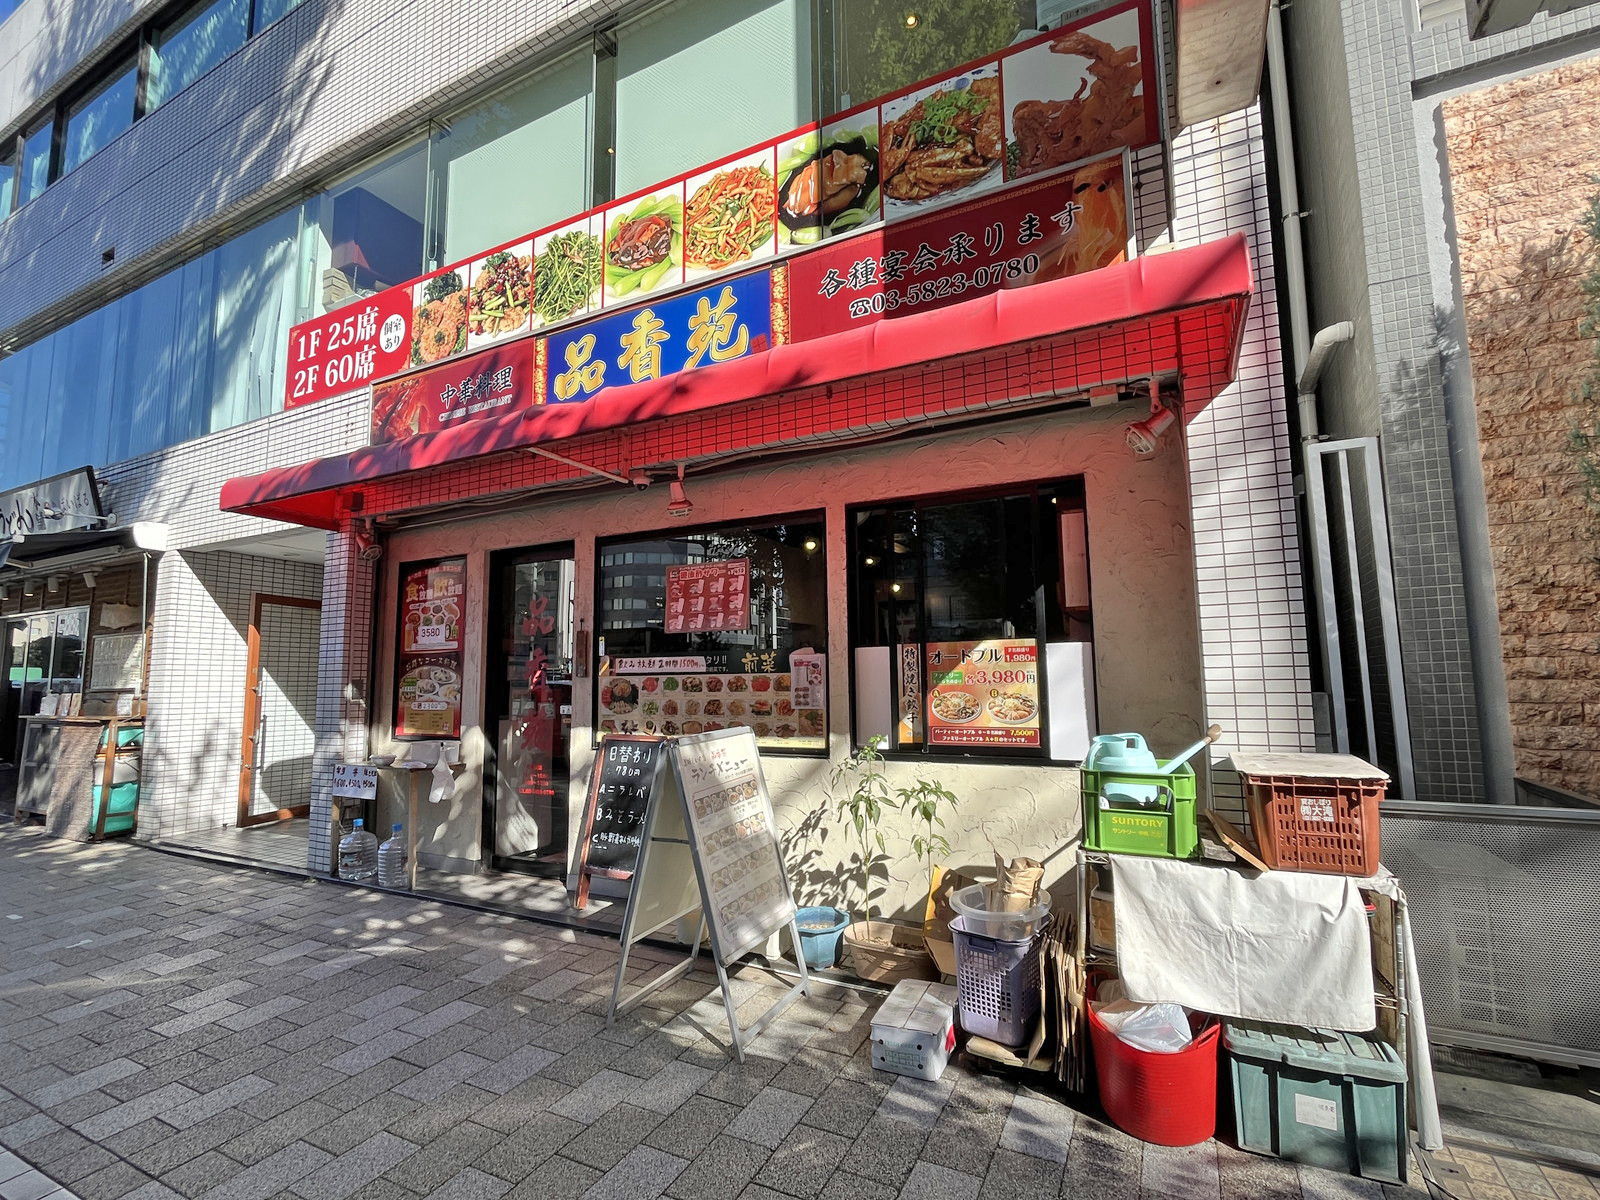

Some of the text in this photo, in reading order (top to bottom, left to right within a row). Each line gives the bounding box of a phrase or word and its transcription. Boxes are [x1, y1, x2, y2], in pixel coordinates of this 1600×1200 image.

[818, 202, 1082, 299] 各種宴会承ります
[870, 253, 1040, 314] 03-5823-0780
[297, 306, 380, 362] 1F 25席
[385, 335, 400, 350] あり
[553, 285, 751, 402] 品香苑
[293, 344, 377, 398] 2F 60席
[440, 365, 513, 410] 中華料理
[421, 628, 440, 637] 3580
[741, 651, 777, 673] 前菜
[929, 647, 1003, 665] オードブル
[1005, 654, 1036, 663] 1,980円
[904, 647, 919, 724] 特製焼き餃子
[609, 746, 651, 764] 日替わり
[1111, 816, 1164, 828] SUNTORY
